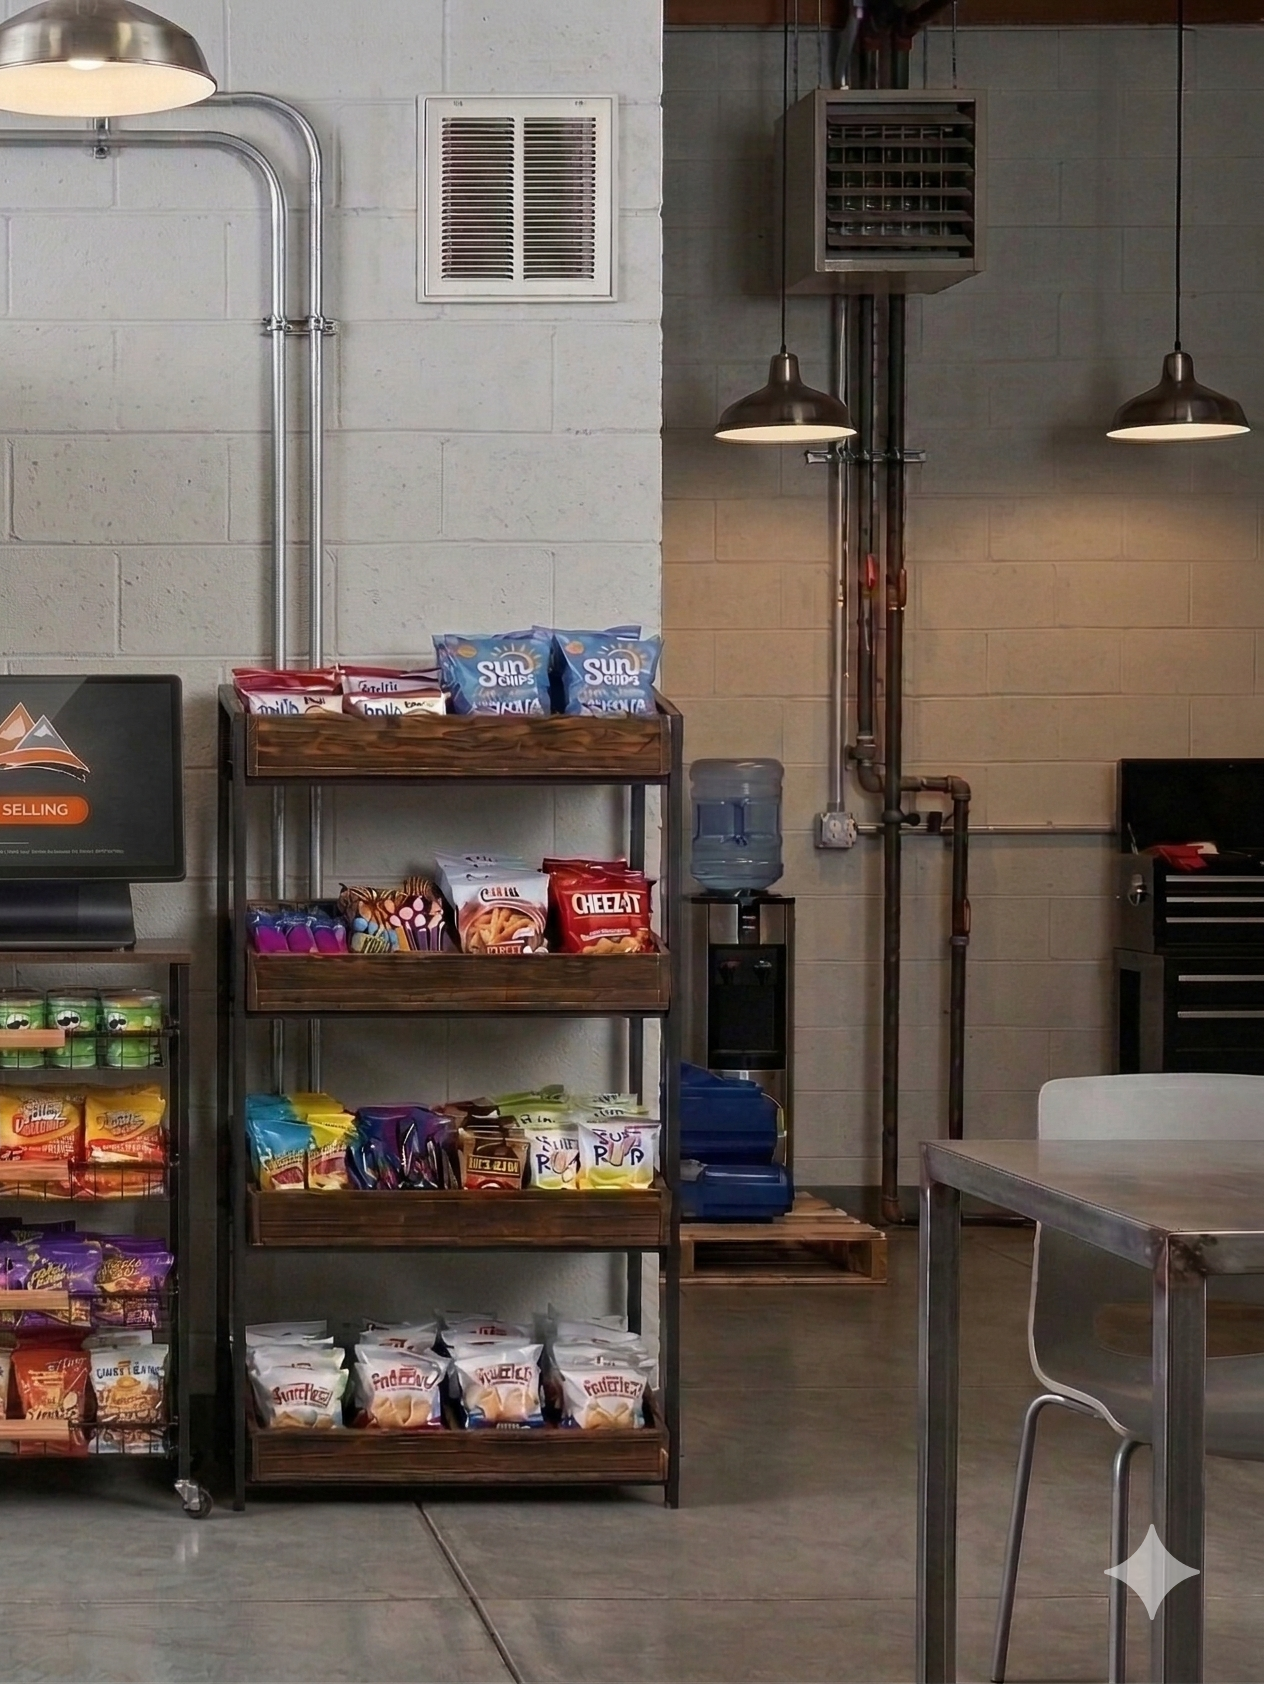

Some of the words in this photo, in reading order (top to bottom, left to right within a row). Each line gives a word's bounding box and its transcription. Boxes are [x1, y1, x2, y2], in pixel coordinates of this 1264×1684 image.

[477, 657, 534, 687] Sun
[583, 656, 640, 686] Sun
[2, 803, 68, 816] SELLING
